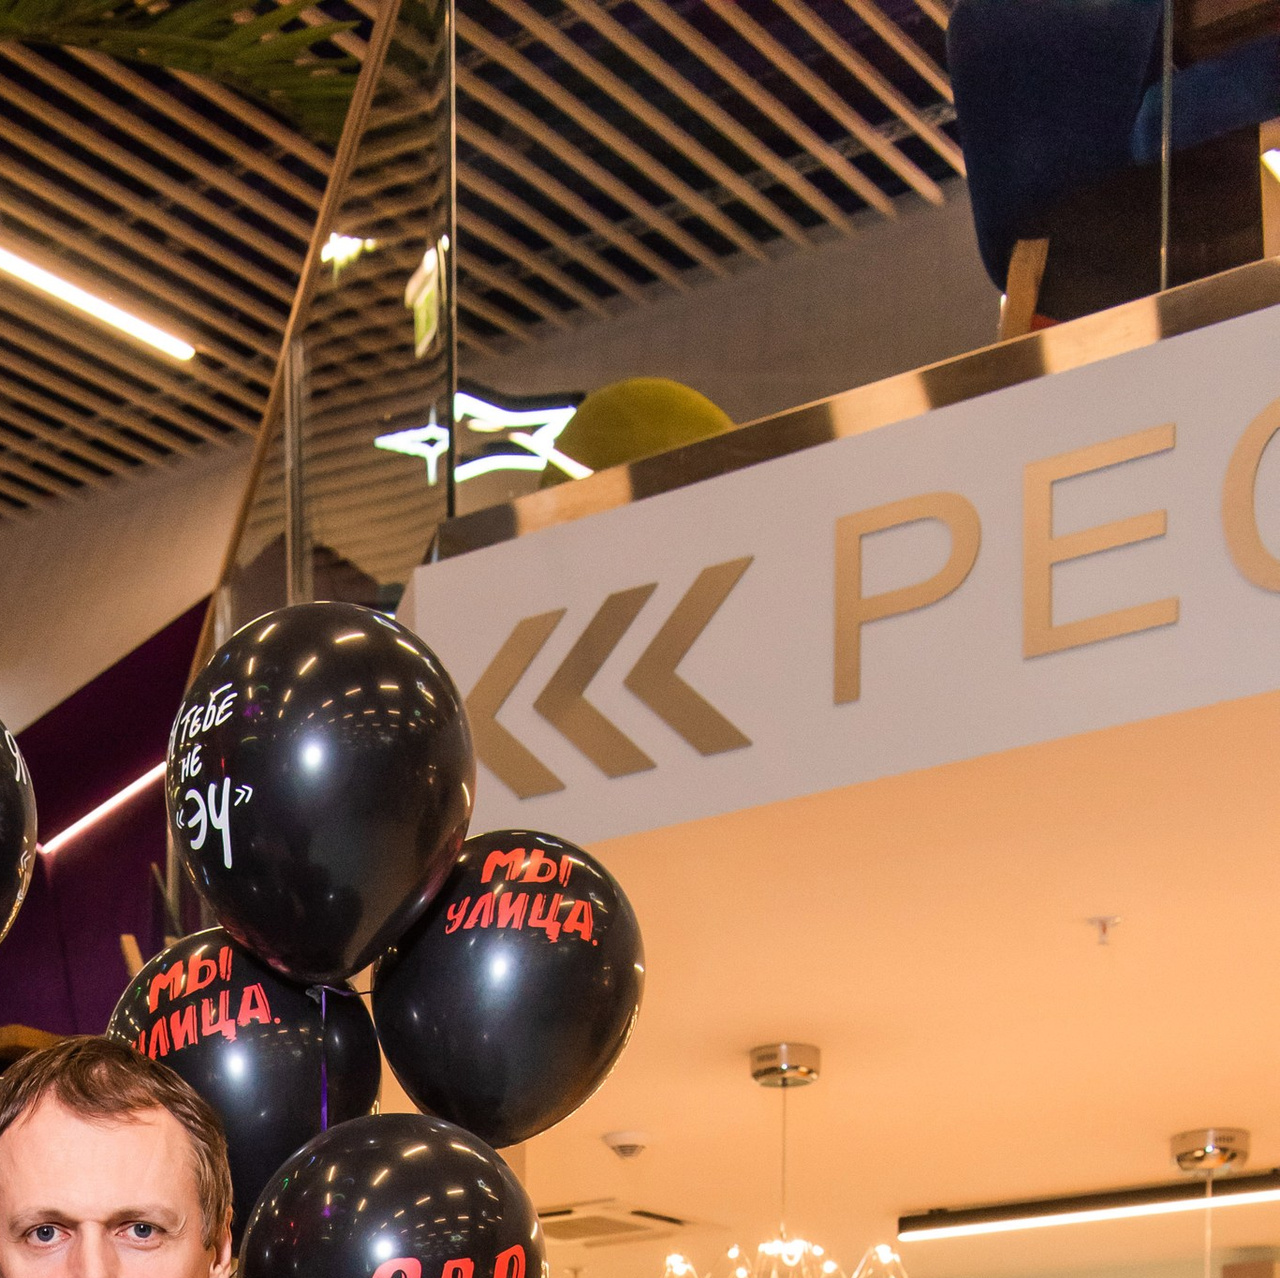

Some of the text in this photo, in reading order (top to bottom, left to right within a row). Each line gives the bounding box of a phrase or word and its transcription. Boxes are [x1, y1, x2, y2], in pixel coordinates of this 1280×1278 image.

[180, 744, 203, 784] НЕ
[480, 847, 574, 889] МЫ
[445, 891, 599, 946] УЛИЦА.
[148, 945, 233, 1014] МЫ
